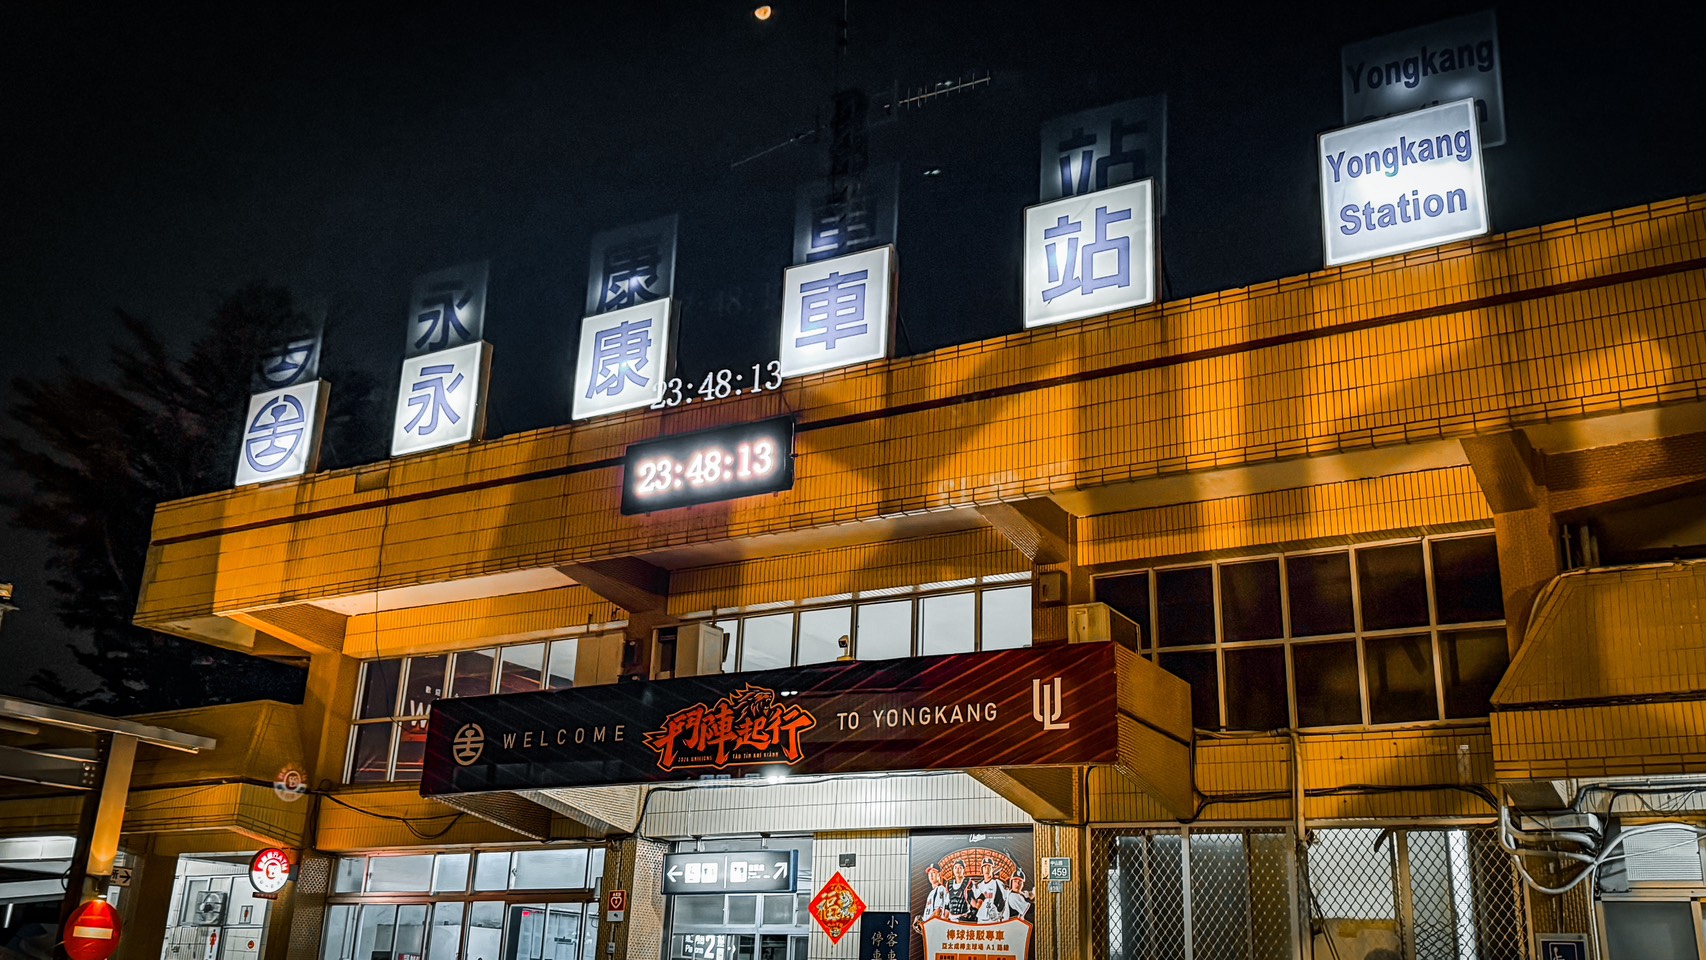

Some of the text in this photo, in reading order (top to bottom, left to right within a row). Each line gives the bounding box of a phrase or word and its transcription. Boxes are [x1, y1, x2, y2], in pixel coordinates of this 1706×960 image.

[1326, 129, 1472, 183] Yongkang
[1340, 188, 1468, 236] Station
[637, 442, 773, 494] 23:48:13
[837, 702, 998, 731] TO YONGKANG
[503, 725, 626, 750] WELCOME
[1051, 867, 1068, 877] 459
[871, 931, 884, 960] 停車
[886, 915, 899, 960] 小客車
[946, 929, 1004, 941] 棒球接駁專車
